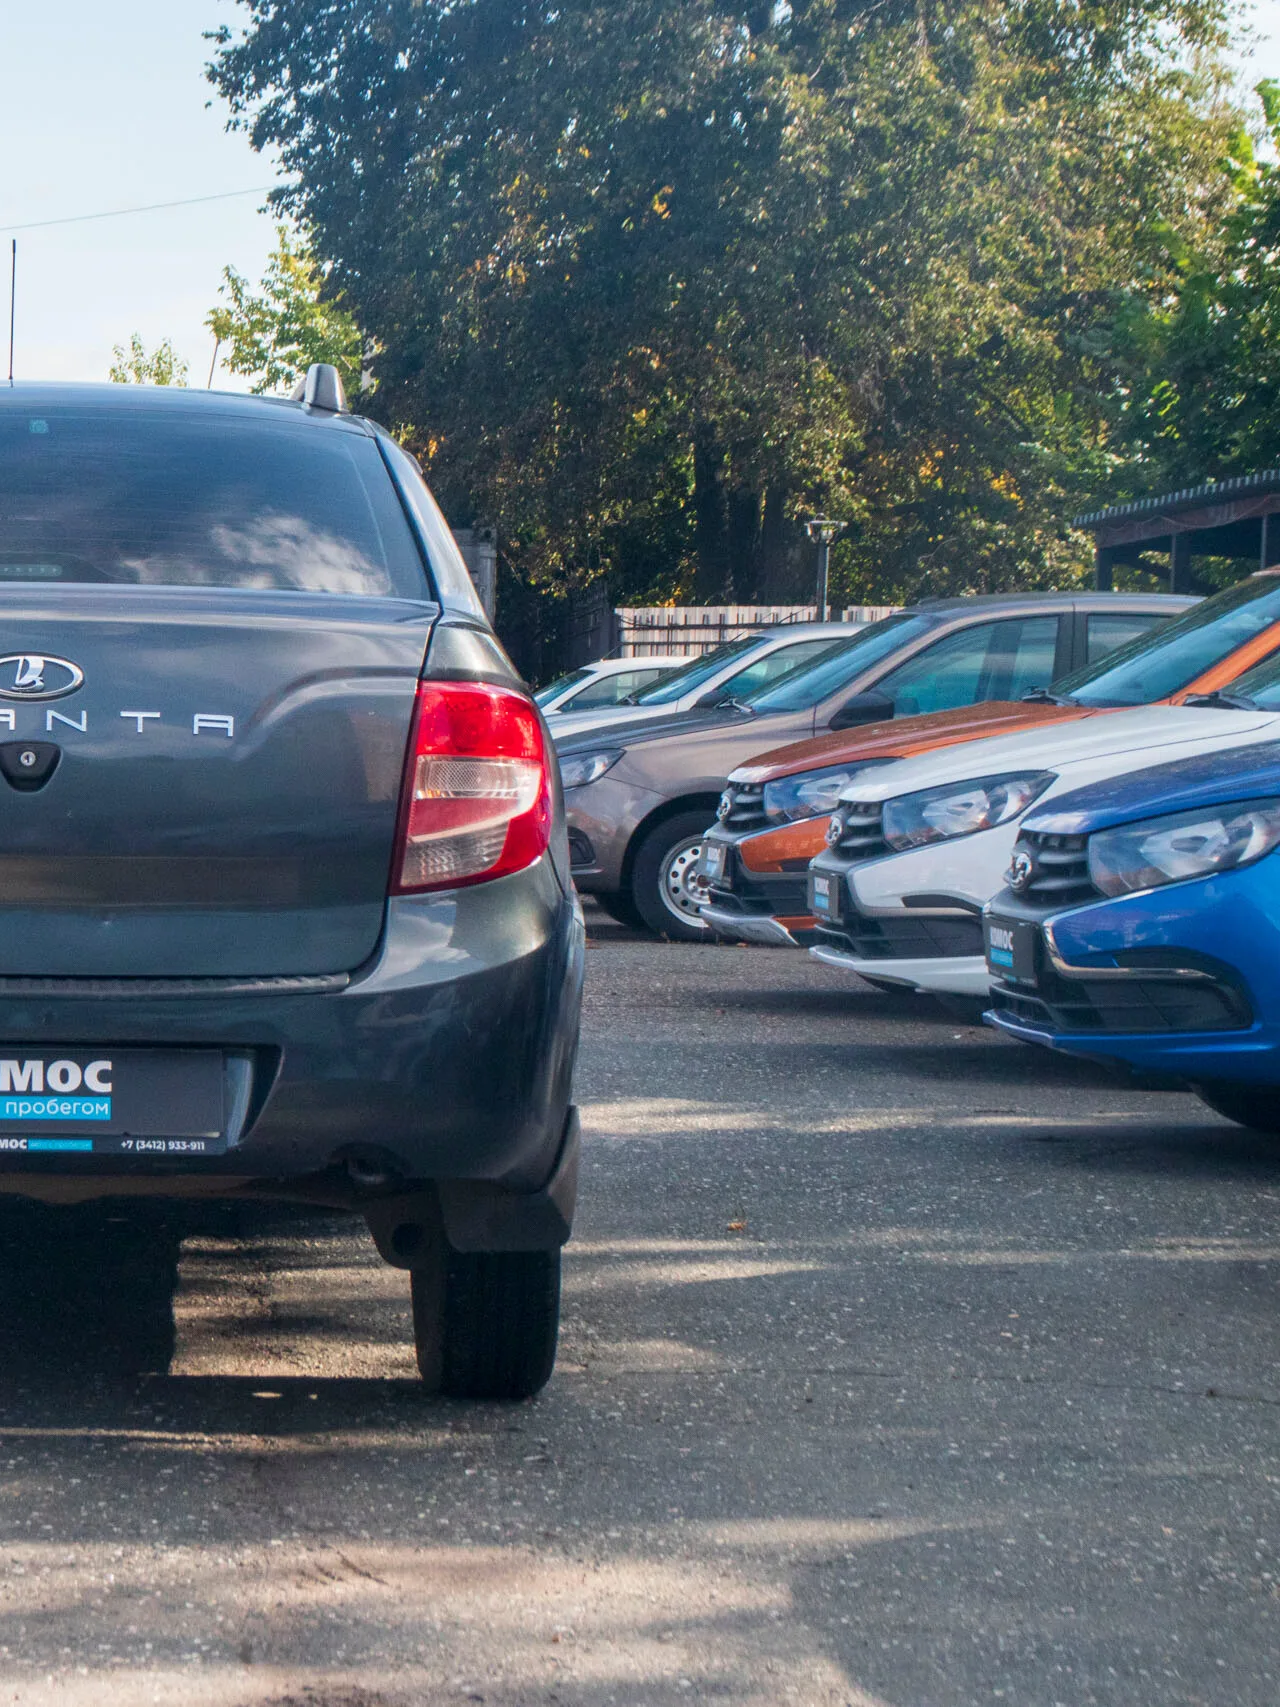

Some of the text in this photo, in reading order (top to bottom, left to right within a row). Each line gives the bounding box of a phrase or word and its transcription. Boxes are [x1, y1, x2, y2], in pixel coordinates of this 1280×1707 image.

[6, 1099, 108, 1116] пробегом
[121, 1140, 205, 1151] +7 (3412) 933-911
